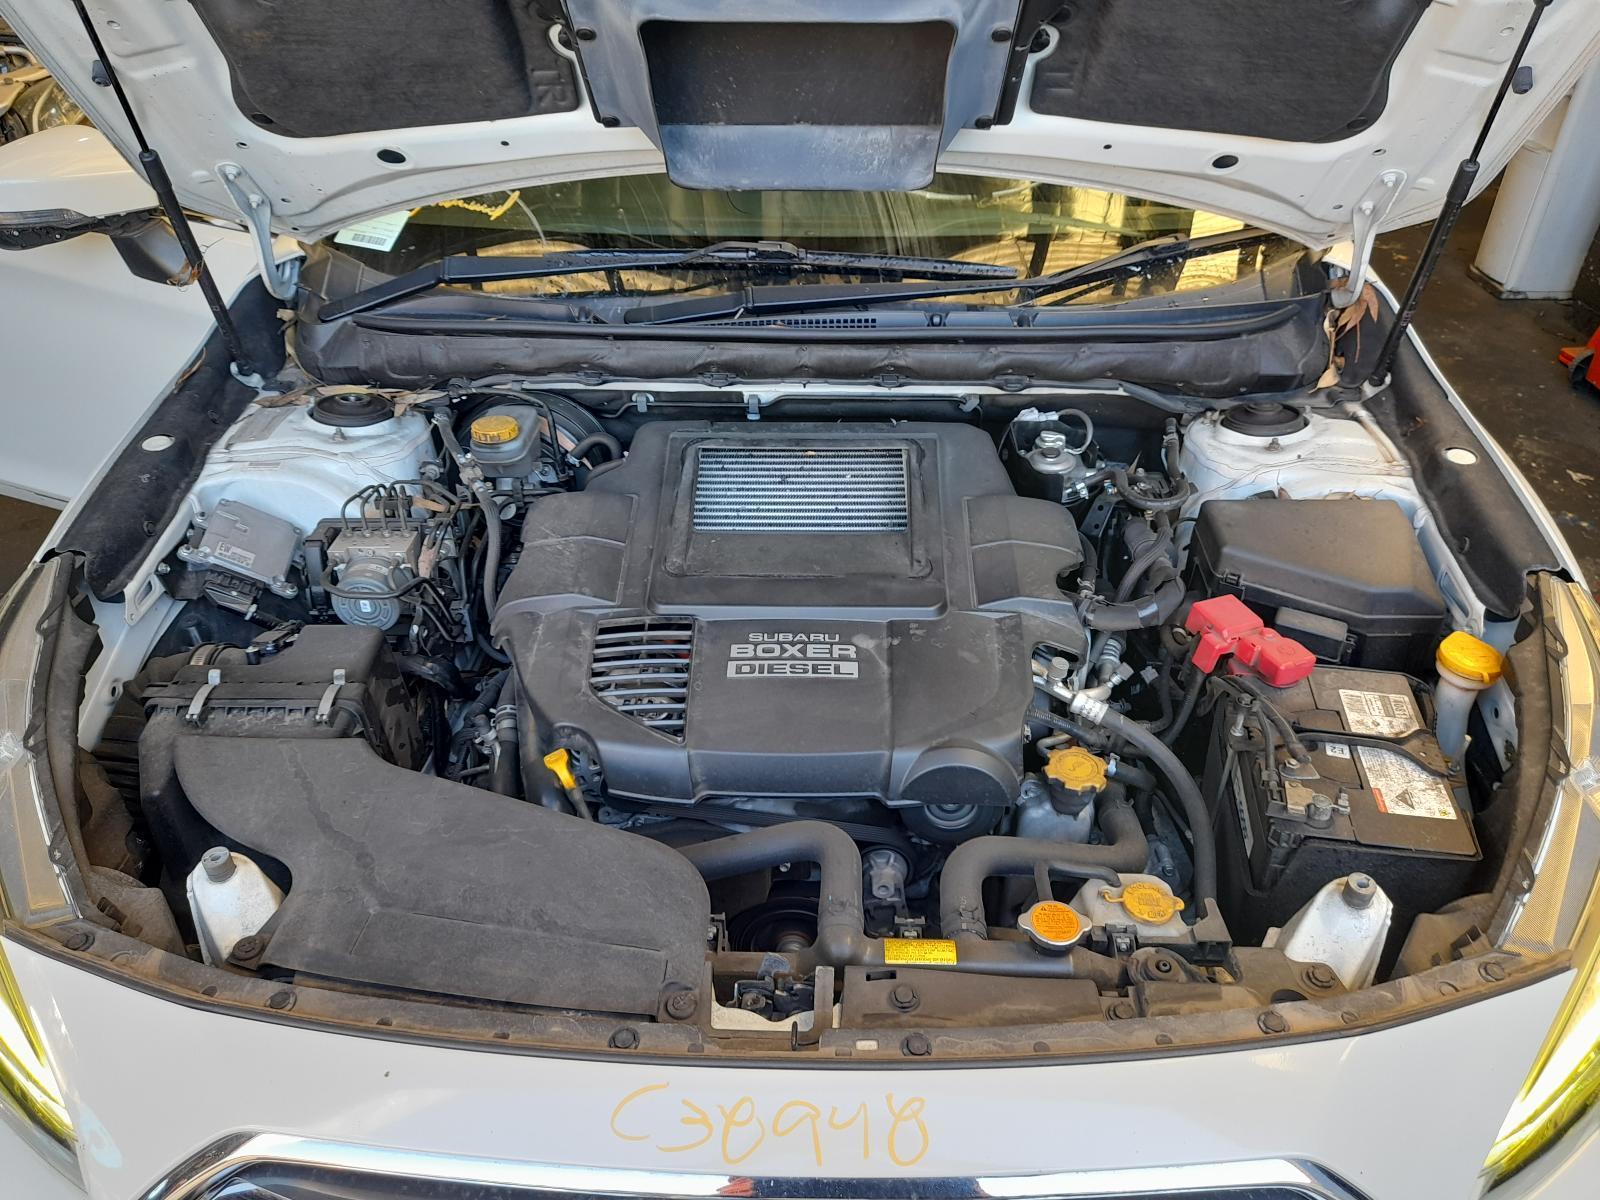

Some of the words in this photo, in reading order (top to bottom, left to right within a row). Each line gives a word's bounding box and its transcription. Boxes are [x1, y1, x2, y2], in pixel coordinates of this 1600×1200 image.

[749, 633, 839, 641] SUBARU
[730, 644, 856, 658] BOXER
[733, 662, 857, 676] DIESEL
